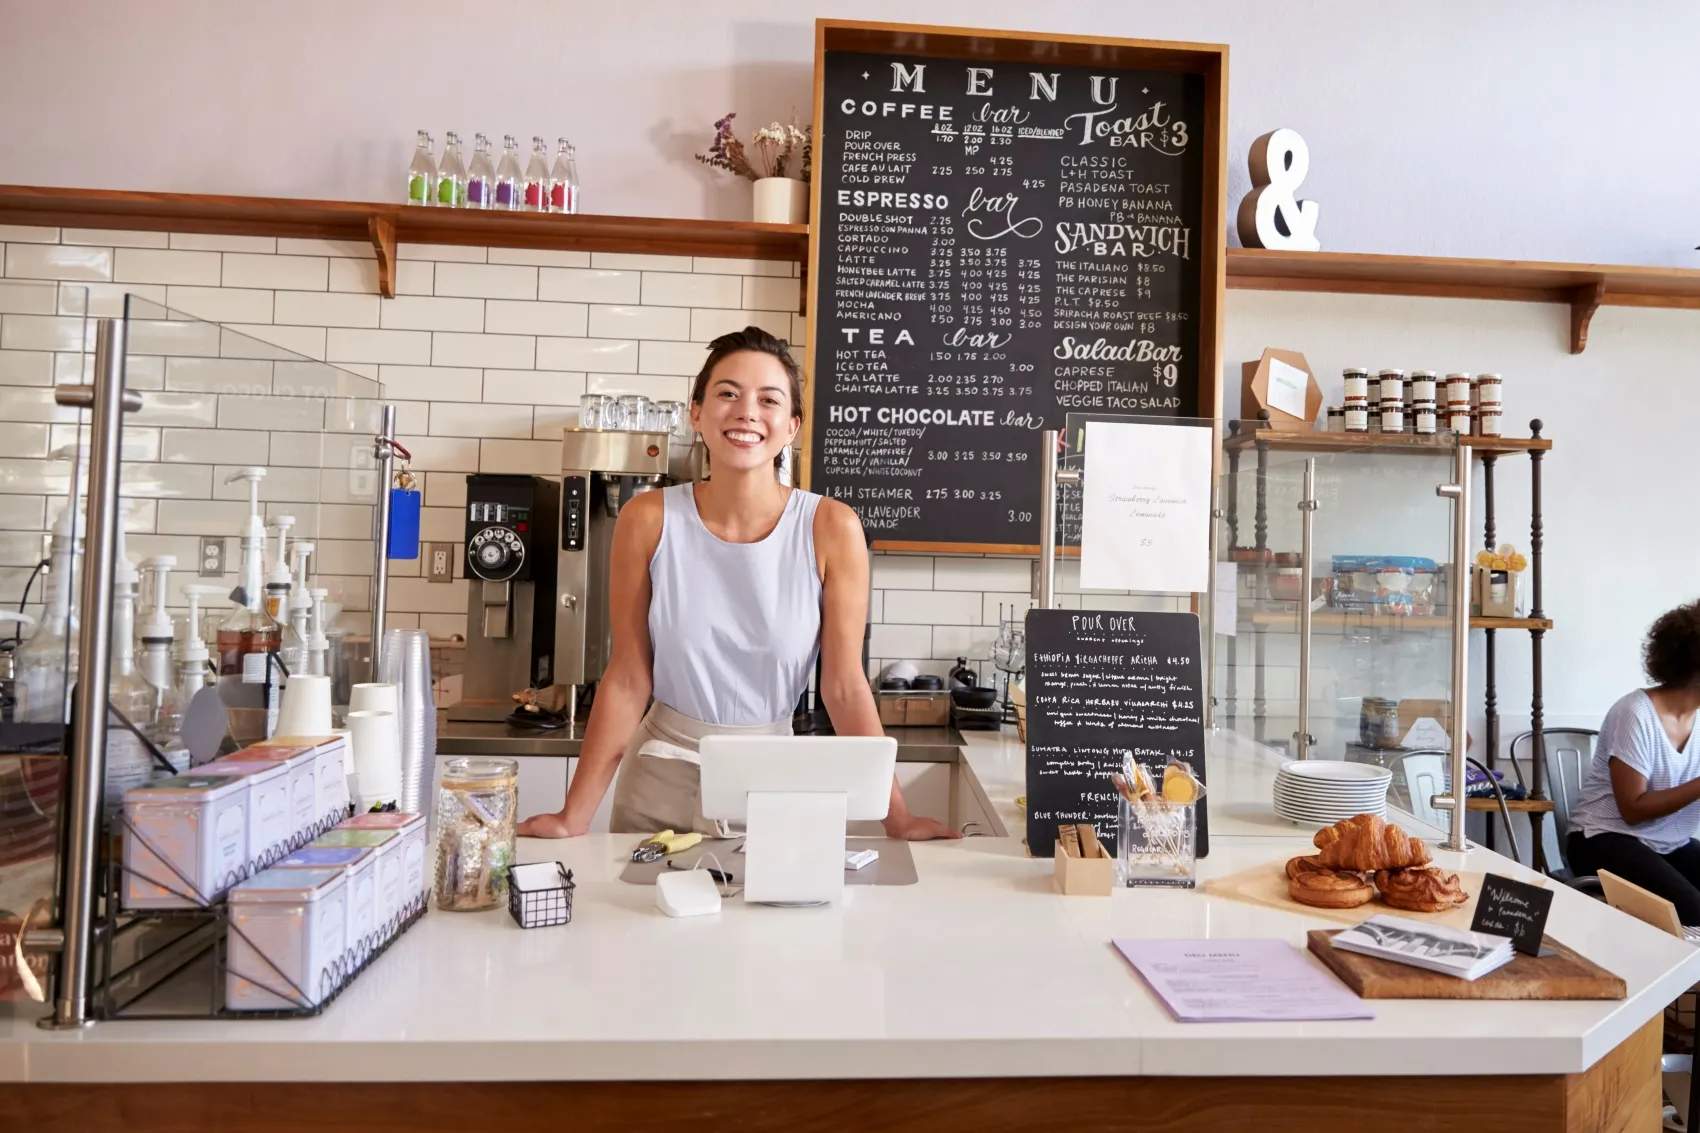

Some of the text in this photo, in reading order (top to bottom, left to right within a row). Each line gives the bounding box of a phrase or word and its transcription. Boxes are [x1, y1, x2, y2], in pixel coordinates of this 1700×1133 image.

[890, 62, 1119, 105] MENU
[841, 99, 1030, 123] COFFEE bar
[1064, 102, 1170, 145] Toast
[846, 131, 871, 139] DRIP
[845, 142, 979, 155] POUR OVER MP
[843, 152, 1013, 165] FRENCH PRESS 4.25
[1061, 156, 1127, 167] CLASSIC
[842, 164, 952, 175] CAFE AU LAIT 2.25
[1061, 169, 1134, 179] L+H TOAST
[842, 175, 904, 184] COLD BREW
[1060, 182, 1169, 194] PASADENA TOAST
[838, 190, 949, 210] ESPRESSO
[1059, 197, 1172, 210] PB HONEY BANANA
[839, 213, 951, 225] DOUBLE SHOT 2.25
[1110, 212, 1183, 225] PB BANANA
[897, 226, 927, 234] PANNA
[838, 235, 955, 246] CORTADO 3.00
[1055, 222, 1190, 259] SANDWICH
[838, 245, 908, 254] CAPPUCCINO
[960, 248, 980, 256] 3.50
[985, 248, 1007, 256] 3.75
[1094, 242, 1154, 257] BAR
[839, 256, 875, 264] LATTE
[1018, 260, 1040, 268] 3.75
[1056, 261, 1165, 272] THE ITALIANO $8.50
[838, 266, 916, 276] HONEYBEE LATTE
[836, 277, 925, 288] SALTED CARAMEL LATTE
[1056, 274, 1150, 286] THE PARISIAN $8
[836, 290, 926, 301] FRENCH LAVENDER BREVE
[1056, 286, 1151, 299] THE CAPRESE $9
[837, 301, 875, 309] MOCHA
[1055, 297, 1119, 307] P.L.T. $8.50
[836, 311, 1041, 328] AMERICANO 3.00 3.00
[1054, 309, 1100, 319] SRIRACHA
[1103, 311, 1134, 320] ROAST
[1054, 321, 1155, 334] DESIGN YOUR OWN $8
[841, 328, 1012, 348] TEA bar
[836, 350, 1006, 361] HOT TEA 2.00
[1054, 337, 1183, 362] Salad Bar
[836, 362, 1034, 372] ICED TEA 3.00
[836, 374, 1003, 384] TEA LATTE 2.00 2.70
[1055, 363, 1178, 387] CAPRESE $9
[835, 384, 861, 393] CHAI
[863, 385, 882, 394] TEA
[885, 385, 919, 394] LATTE
[1055, 380, 1148, 393] CHOPPED ITALIAN
[1056, 395, 1181, 408] VEGGIE TACO SALAD
[830, 406, 1044, 429] HOT CHOCOLATE bar
[928, 451, 1027, 461] 3.00 3.50
[857, 488, 913, 500] STEAMER
[1107, 494, 1150, 504] Strawberry
[868, 506, 1031, 522] LAVENDER 3.00
[1129, 509, 1166, 519] Lemonade
[1072, 615, 1135, 631] POUR OVER
[1034, 651, 1070, 662] ETHIOPIA
[1167, 657, 1190, 665] $4.50
[1172, 700, 1193, 709] $4.25
[1074, 747, 1109, 755] LINTONG
[1081, 792, 1118, 802] FRENCH
[1035, 812, 1051, 820] BLUE
